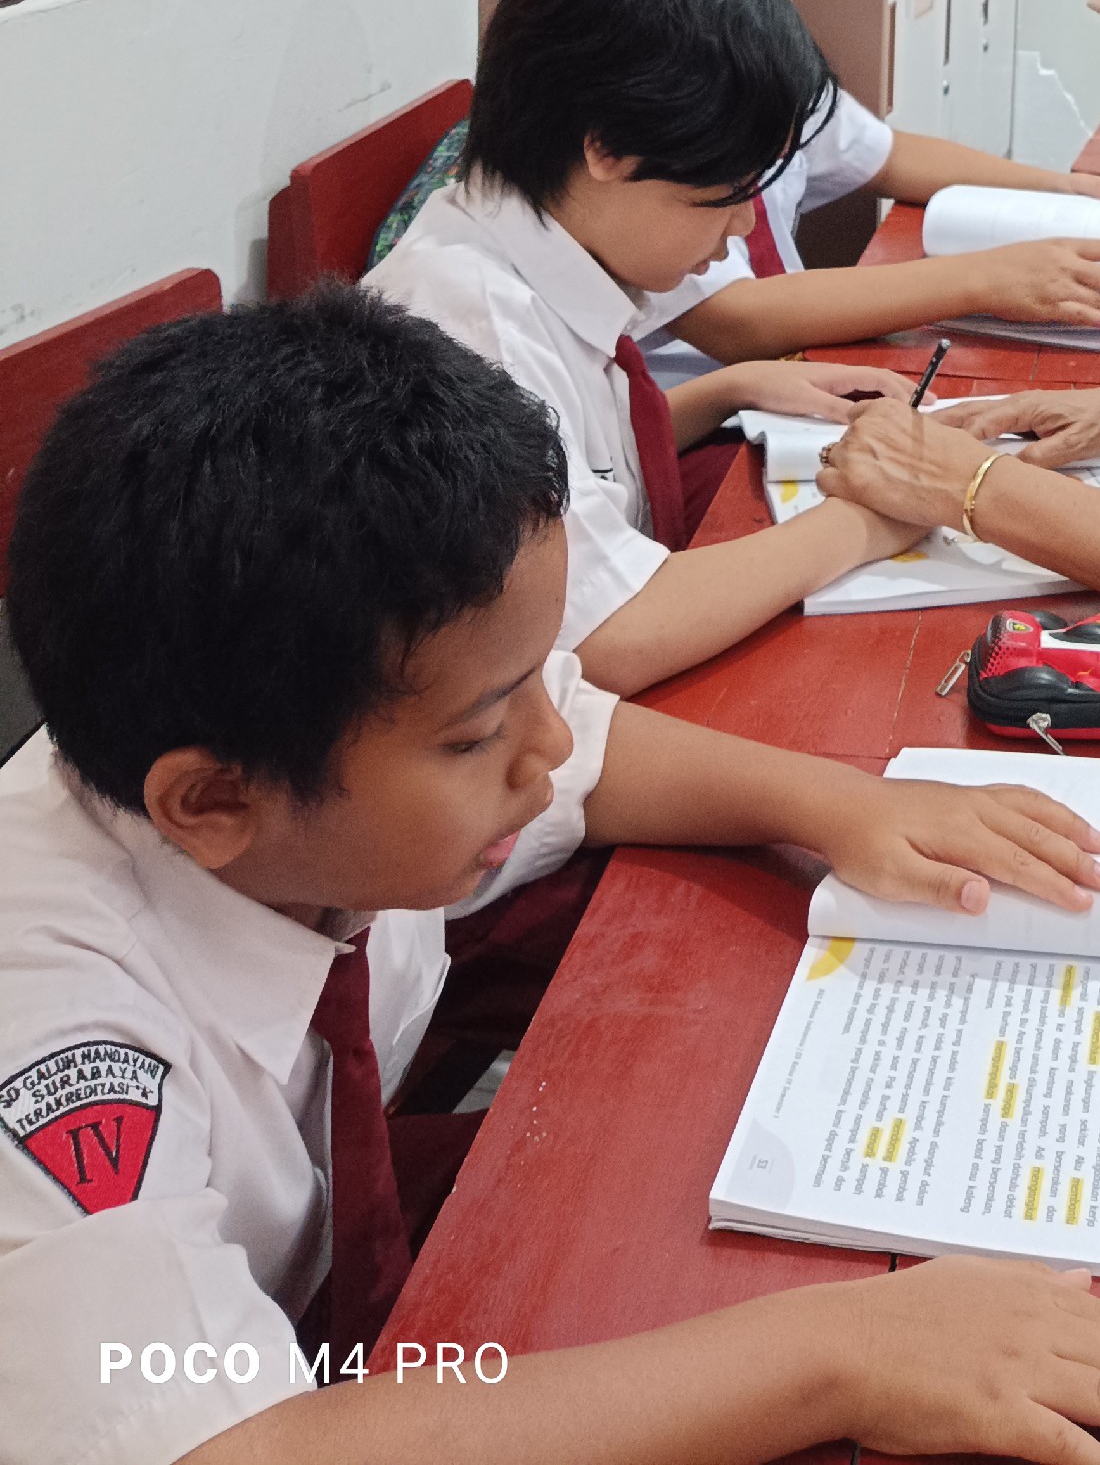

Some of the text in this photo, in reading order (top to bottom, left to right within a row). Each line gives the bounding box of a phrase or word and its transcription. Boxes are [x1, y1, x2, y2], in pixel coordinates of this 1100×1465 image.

[22, 1051, 78, 1092] GALUH
[32, 1063, 139, 1105] SURABAYA
[1062, 1079, 1073, 1116] makanan
[978, 1103, 991, 1134] sampah
[997, 1121, 1009, 1141] daun
[1055, 1123, 1066, 1142] yang
[66, 1115, 124, 1185] IV
[990, 1144, 1002, 1164] yang
[1034, 1145, 1045, 1160] Adi
[1073, 1154, 1084, 1171] Aku
[968, 1162, 979, 1181] atau
[1008, 1162, 1021, 1192] dahulu
[1050, 1150, 1064, 1197] berserakan
[916, 1179, 929, 1205] dalam
[960, 1185, 976, 1212] kaleng
[1024, 1166, 1040, 1220] mengangkat
[1065, 1177, 1080, 1224] membantu
[1003, 1193, 1015, 1218] dekat
[1045, 1205, 1056, 1222] dan
[1086, 1205, 1098, 1227] kerja
